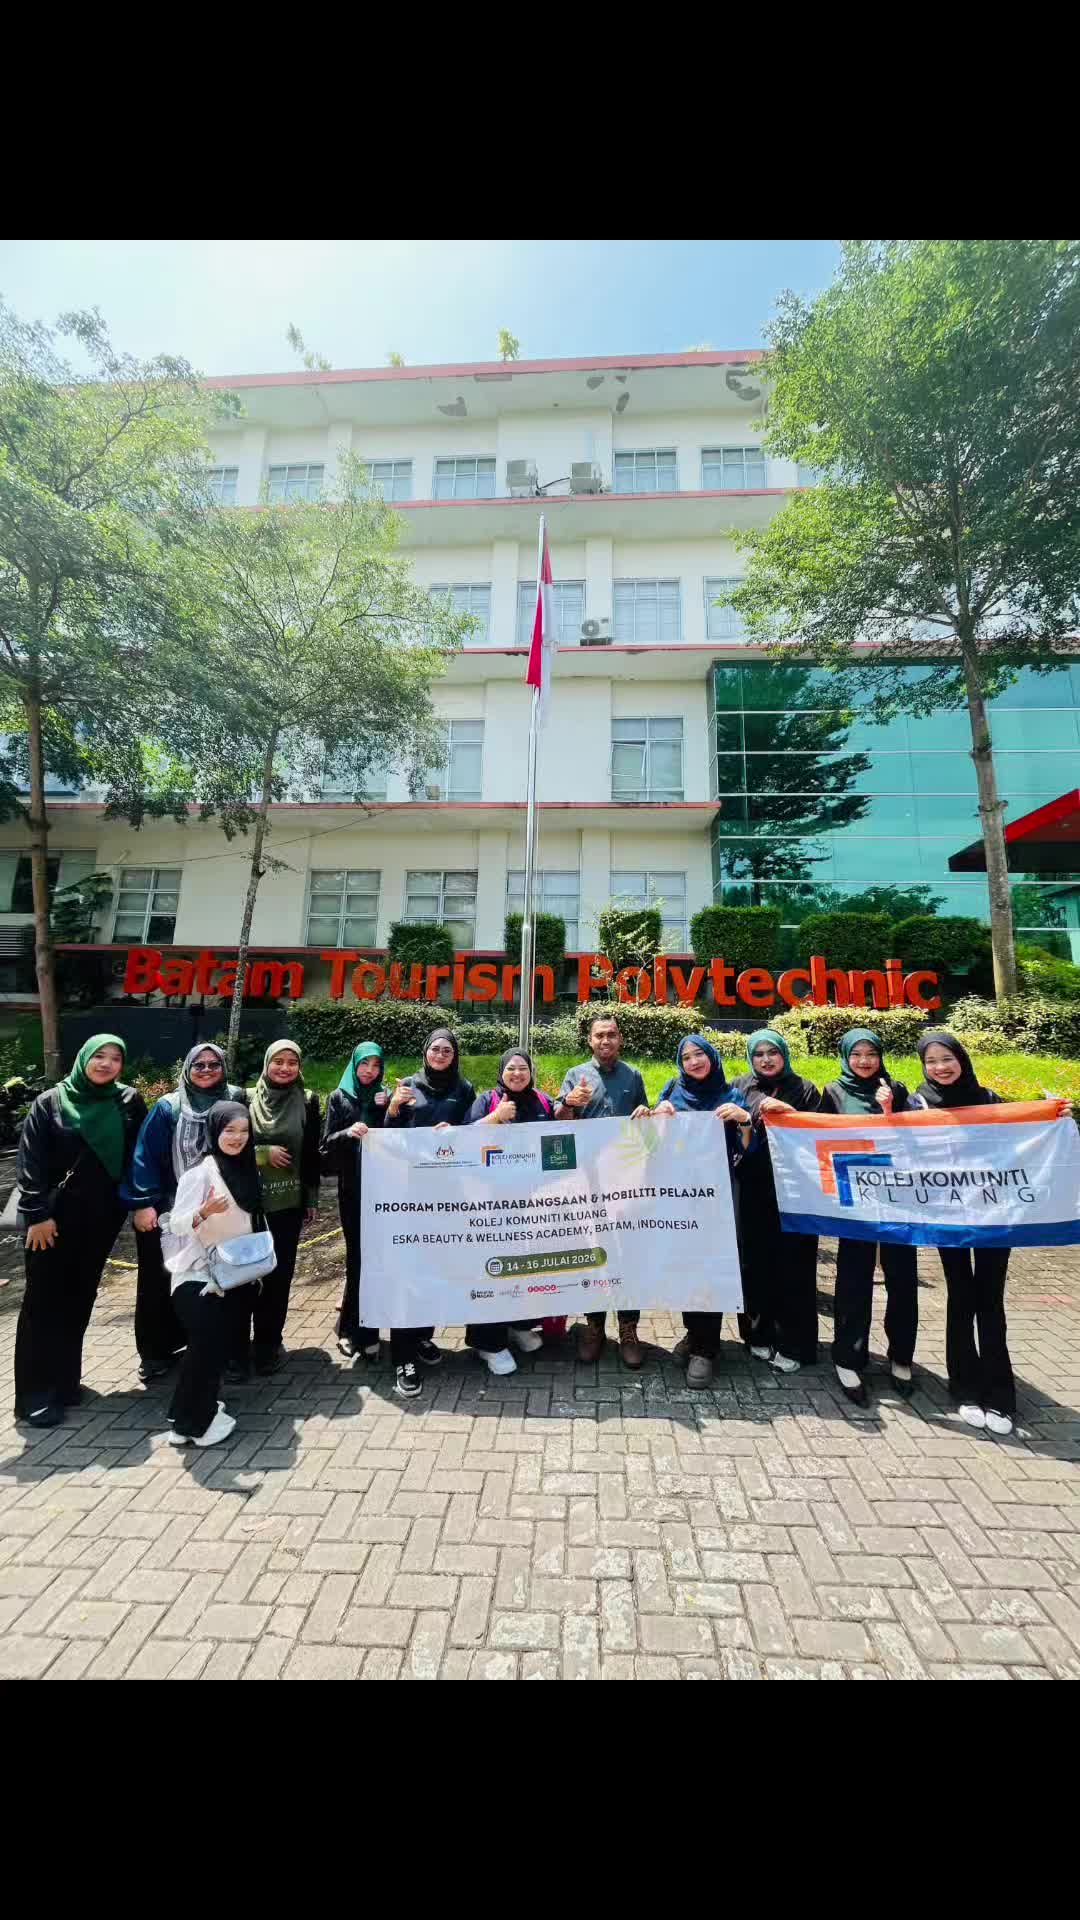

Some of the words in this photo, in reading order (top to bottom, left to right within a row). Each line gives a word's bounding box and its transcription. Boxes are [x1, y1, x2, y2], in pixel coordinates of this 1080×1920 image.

[123, 947, 305, 999] Batam
[321, 950, 555, 1003] Tourism
[577, 951, 943, 1009] Polytechnic
[855, 1170, 914, 1187] KOLEJ
[920, 1168, 1029, 1188] KOMUNITI
[374, 1202, 434, 1213] PROGRAM
[437, 1195, 587, 1212] PENGANTARABANGSAAN
[591, 1193, 598, 1204] &
[602, 1187, 657, 1202] MOBILITI
[659, 1187, 716, 1198] PELAJAR
[859, 1186, 1036, 1204] KLUANG
[469, 1217, 503, 1228] KOLEJ
[505, 1213, 561, 1227] KOMUNITI
[563, 1209, 607, 1223] KLUANG
[392, 1234, 420, 1245] ESKA
[422, 1233, 463, 1244] BEAUTY
[466, 1233, 473, 1243] &
[475, 1230, 533, 1243] WELLNESS
[535, 1226, 592, 1240] ACADEMY,
[595, 1220, 635, 1233] BATAM,
[637, 1218, 699, 1230] INDONESIA
[506, 1262, 519, 1272] 14
[528, 1260, 539, 1270] 16
[541, 1257, 570, 1268] JULAI
[572, 1253, 596, 1265] 2026
